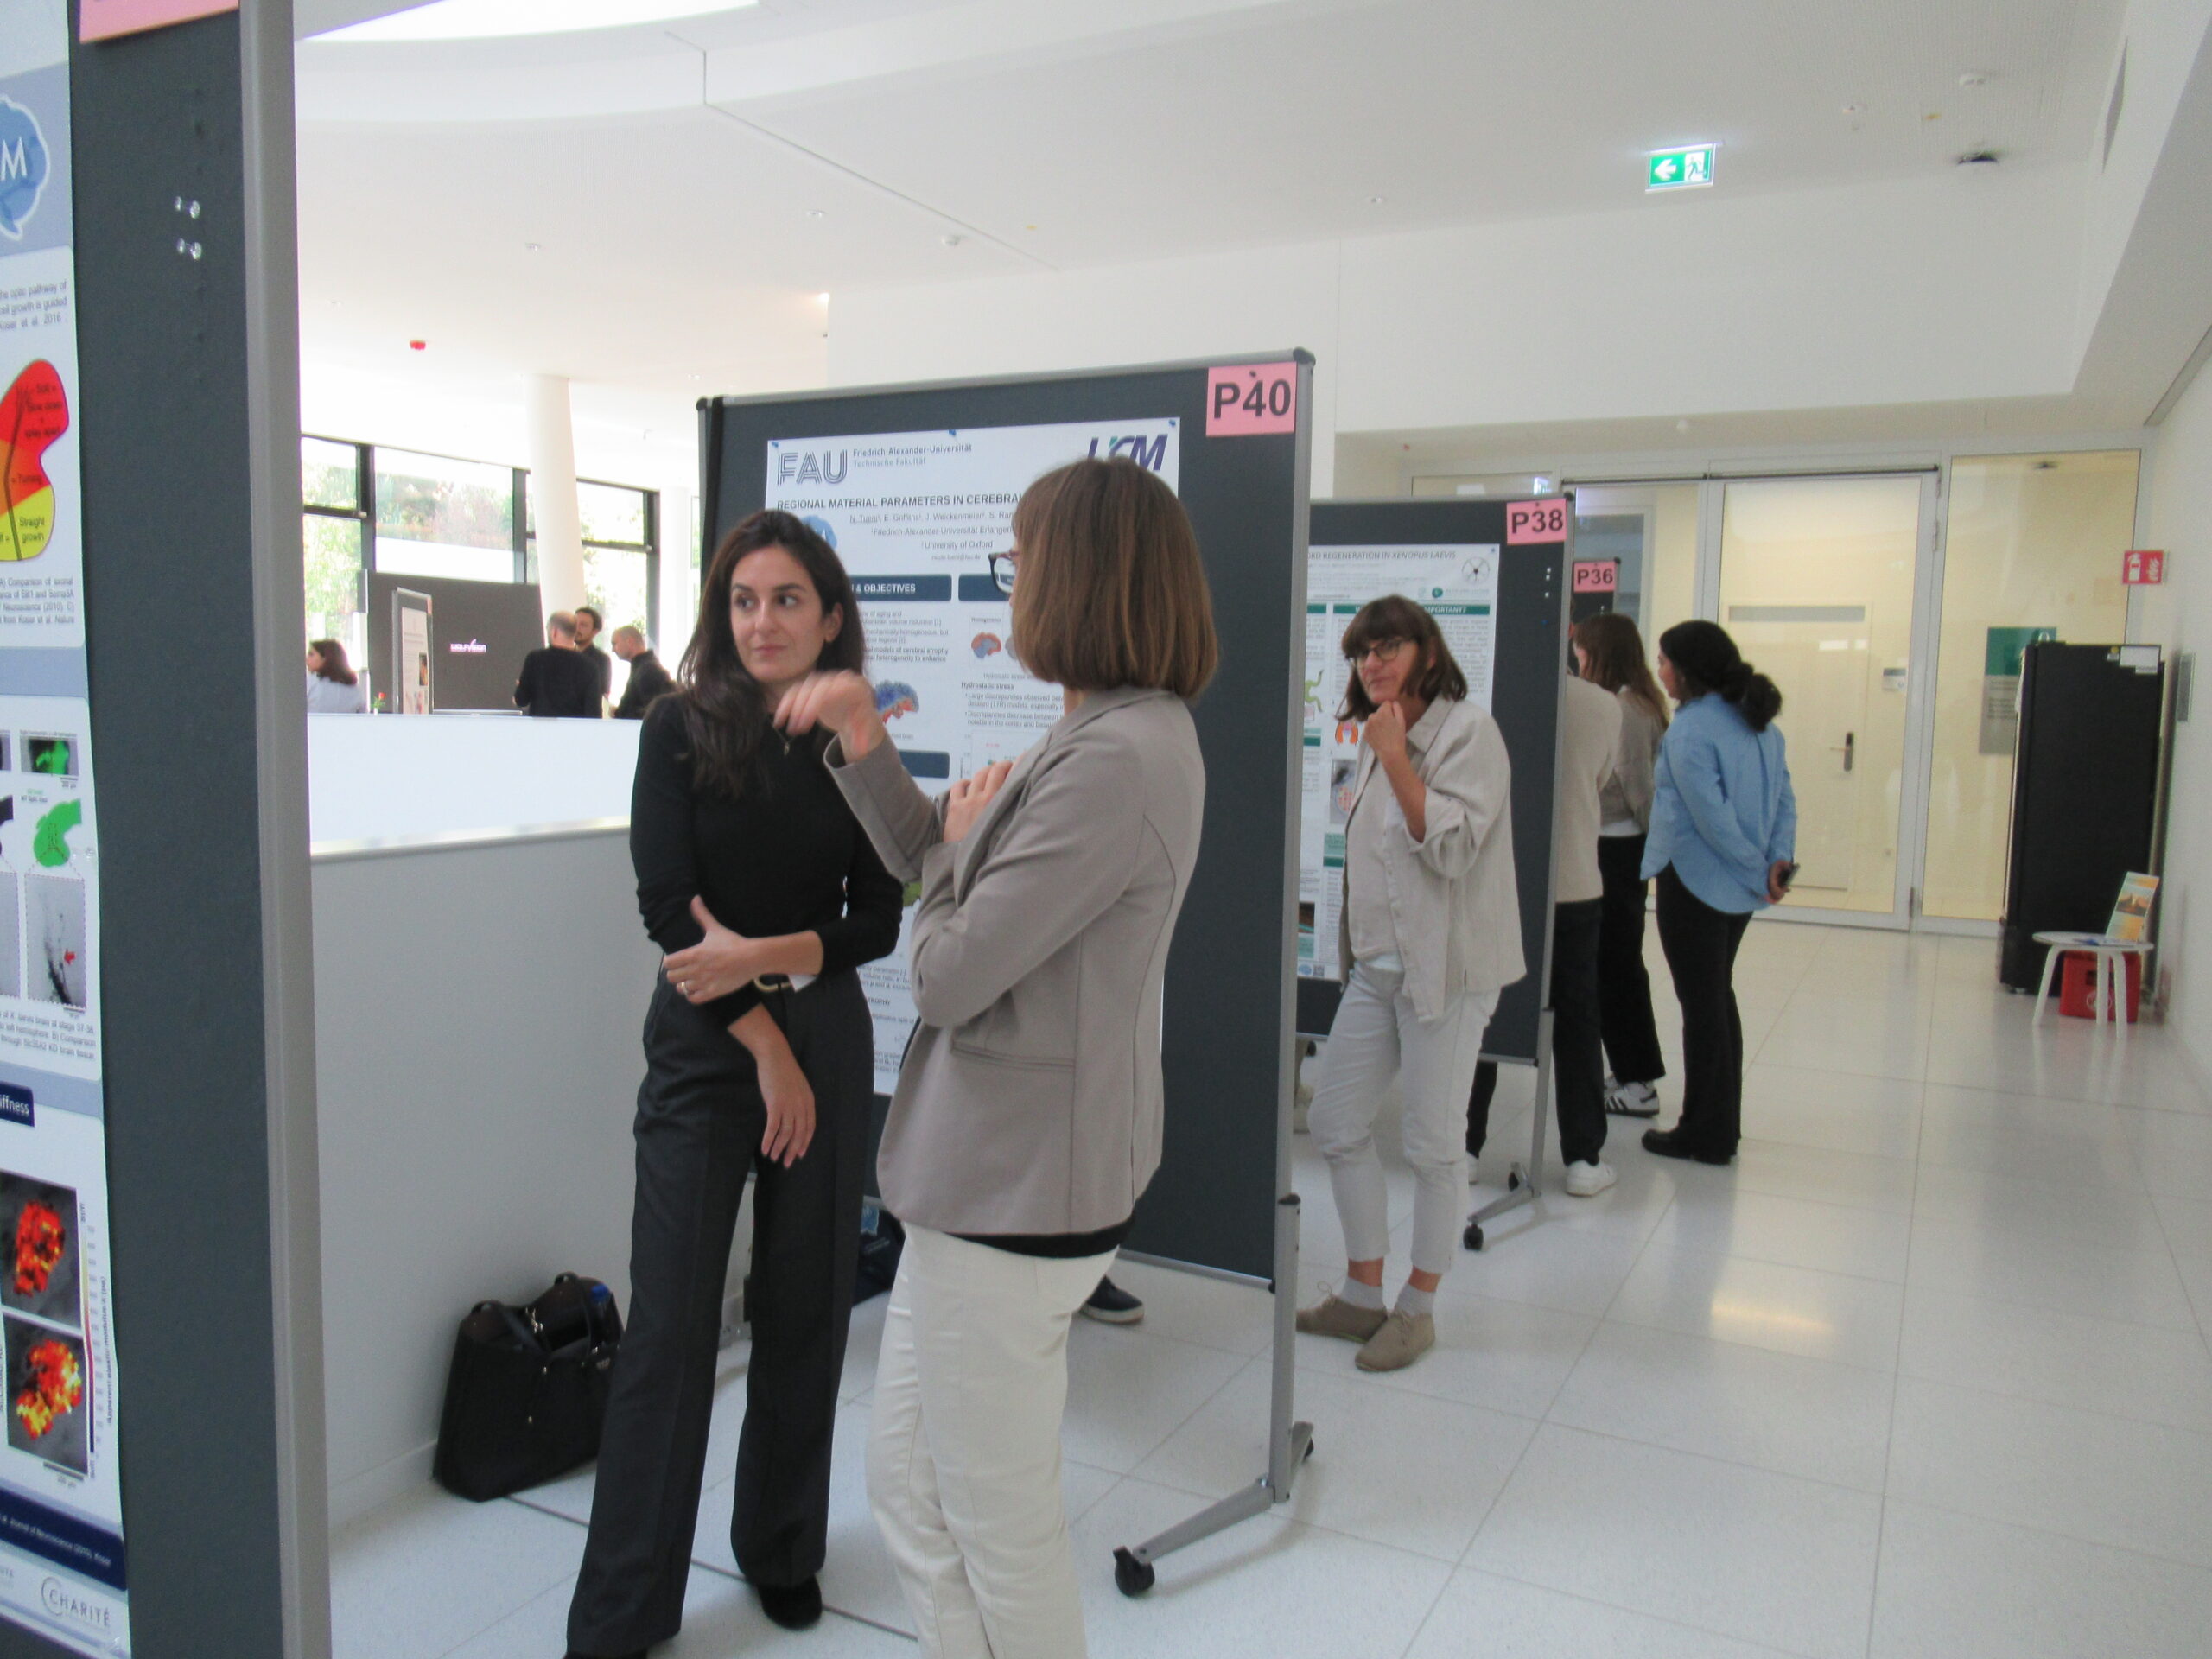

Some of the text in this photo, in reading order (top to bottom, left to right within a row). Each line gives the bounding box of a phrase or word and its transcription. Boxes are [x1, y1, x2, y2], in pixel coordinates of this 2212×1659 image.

[1213, 378, 1291, 420] P40
[778, 448, 848, 486] FAU
[853, 460, 893, 468] Technische
[778, 499, 825, 511] REGIONAL
[829, 497, 878, 508] MATERIAL
[880, 495, 950, 507] PARAMETERS
[953, 494, 963, 505] IN
[1512, 509, 1563, 534] P38
[969, 540, 993, 549] Oxford
[1323, 551, 1380, 560] REGENERATION
[1391, 551, 1428, 560] XENOPUS
[1430, 550, 1457, 559] LAEVIS
[1577, 569, 1613, 585] P36
[864, 582, 916, 594] OBJECTIVES
[1425, 606, 1467, 614] MPORTANT?
[961, 681, 995, 690] Hydrostatic
[48, 1588, 111, 1628] CHARITÉ
